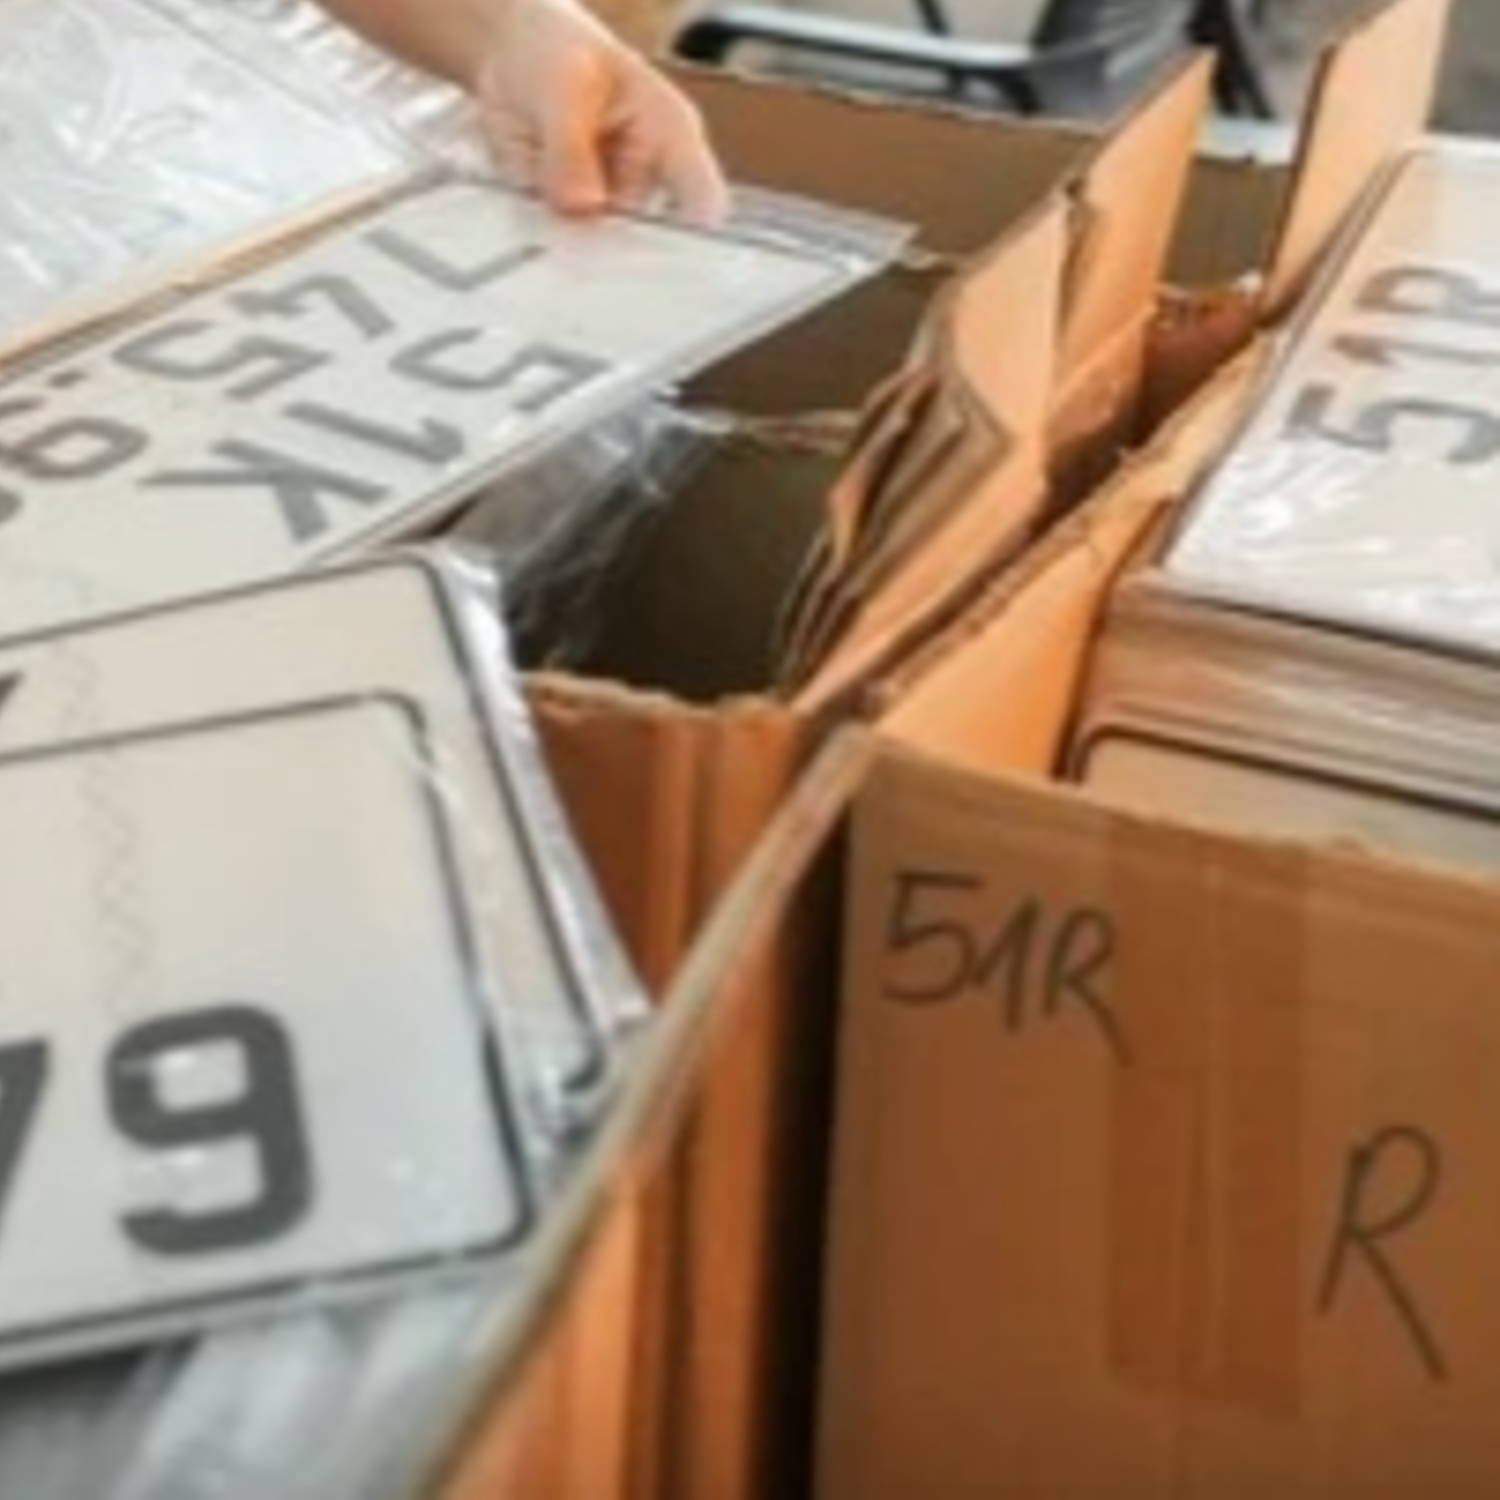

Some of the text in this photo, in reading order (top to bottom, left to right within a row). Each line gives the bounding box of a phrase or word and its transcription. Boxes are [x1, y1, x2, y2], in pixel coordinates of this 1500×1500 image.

[138, 325, 616, 542] 51K
[882, 870, 1132, 1066] 51R
[1316, 1126, 1447, 1381] R
